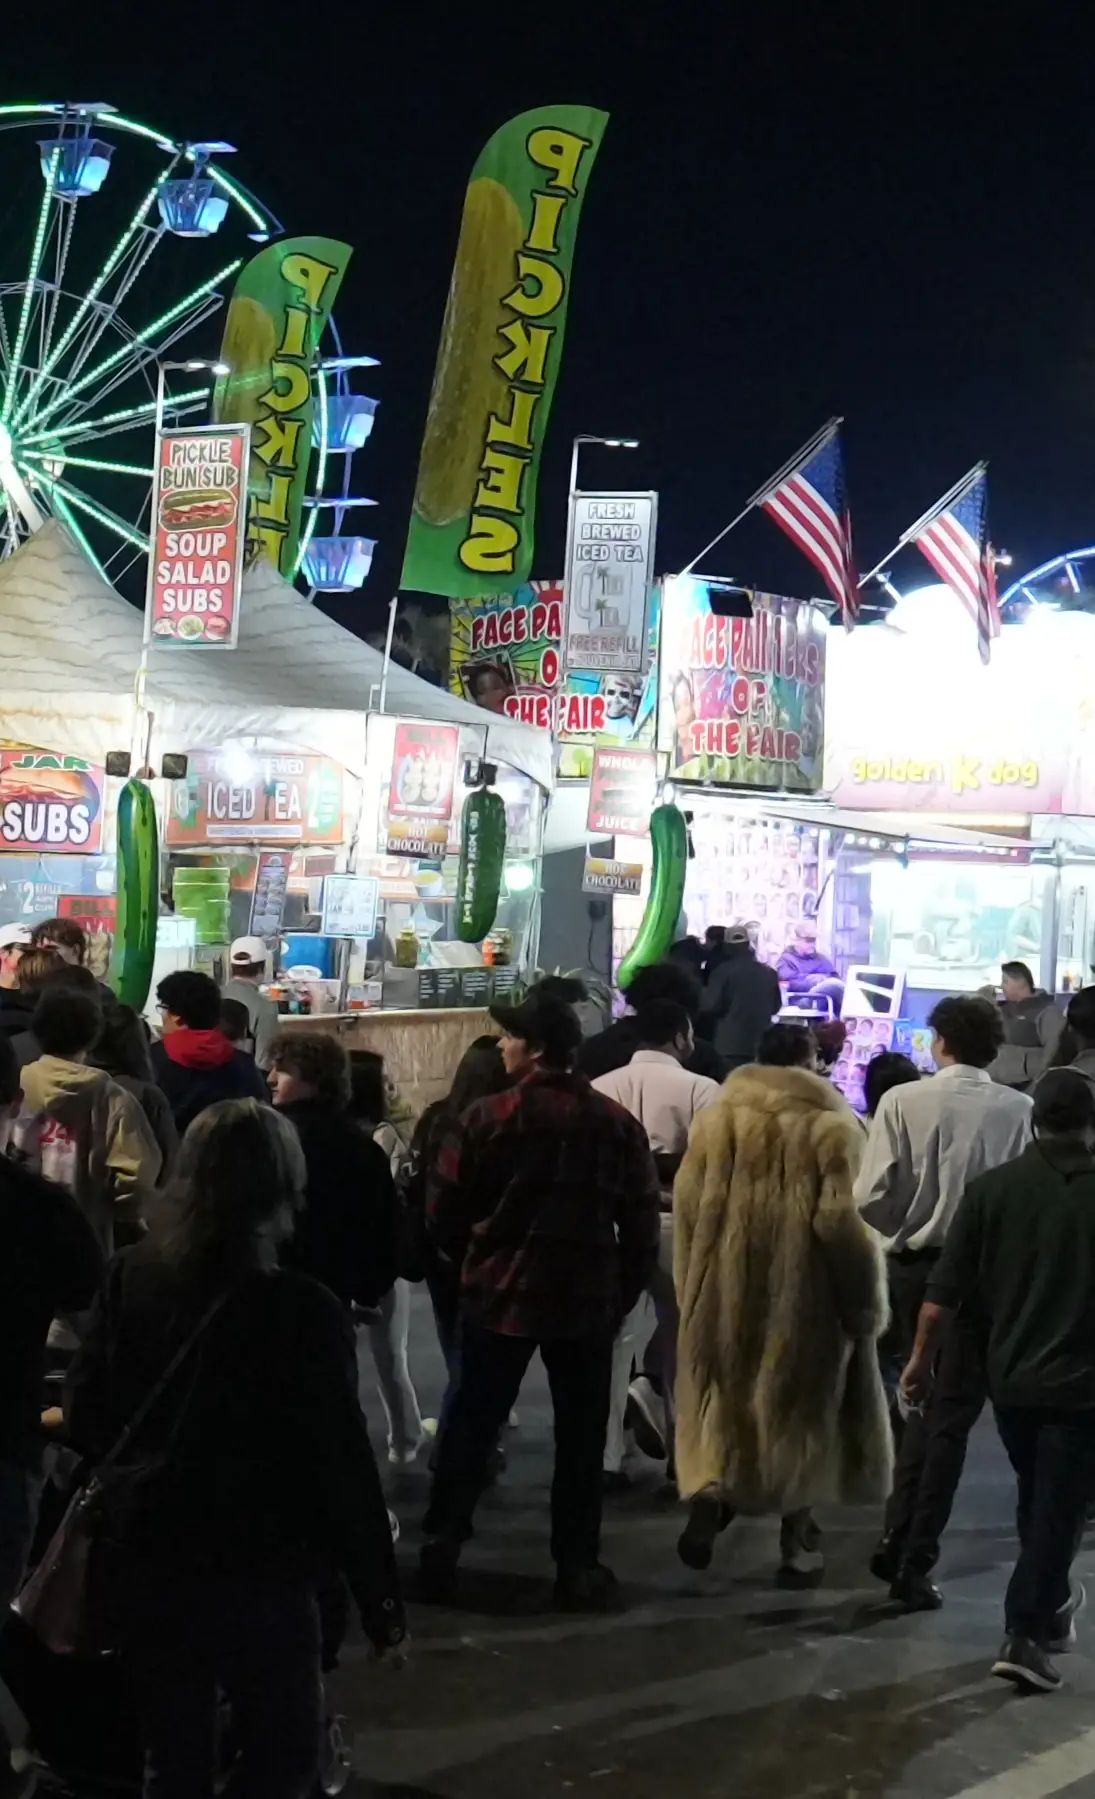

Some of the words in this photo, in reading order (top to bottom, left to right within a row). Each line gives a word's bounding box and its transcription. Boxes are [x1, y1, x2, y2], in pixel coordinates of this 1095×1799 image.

[172, 440, 232, 465] PICKLE
[162, 465, 197, 489] BUN
[201, 463, 238, 488] SUB
[588, 502, 636, 519] FRESH
[164, 532, 227, 557] SOUP
[581, 523, 642, 541] BREWED
[575, 544, 610, 561] ICED
[614, 545, 644, 562] TEA
[157, 560, 231, 585] SALAD
[162, 587, 223, 613] SUBS
[471, 605, 528, 650] FACE
[569, 633, 600, 652] FREE
[601, 634, 640, 653] REFILL
[690, 612, 728, 670] ACE
[540, 648, 559, 686] O
[732, 676, 768, 715] OF
[505, 695, 551, 728] THE
[690, 719, 741, 757] THE
[746, 721, 802, 763] FAIR
[11, 754, 93, 771] JAR
[850, 757, 944, 785] golden
[951, 754, 981, 795] K
[988, 760, 1039, 787] dog
[206, 781, 255, 819] ICED
[2, 801, 91, 844] SUBS
[386, 839, 446, 857] CHOCOLATE
[605, 861, 627, 875] HOT
[585, 874, 640, 890] CHOCOLATE
